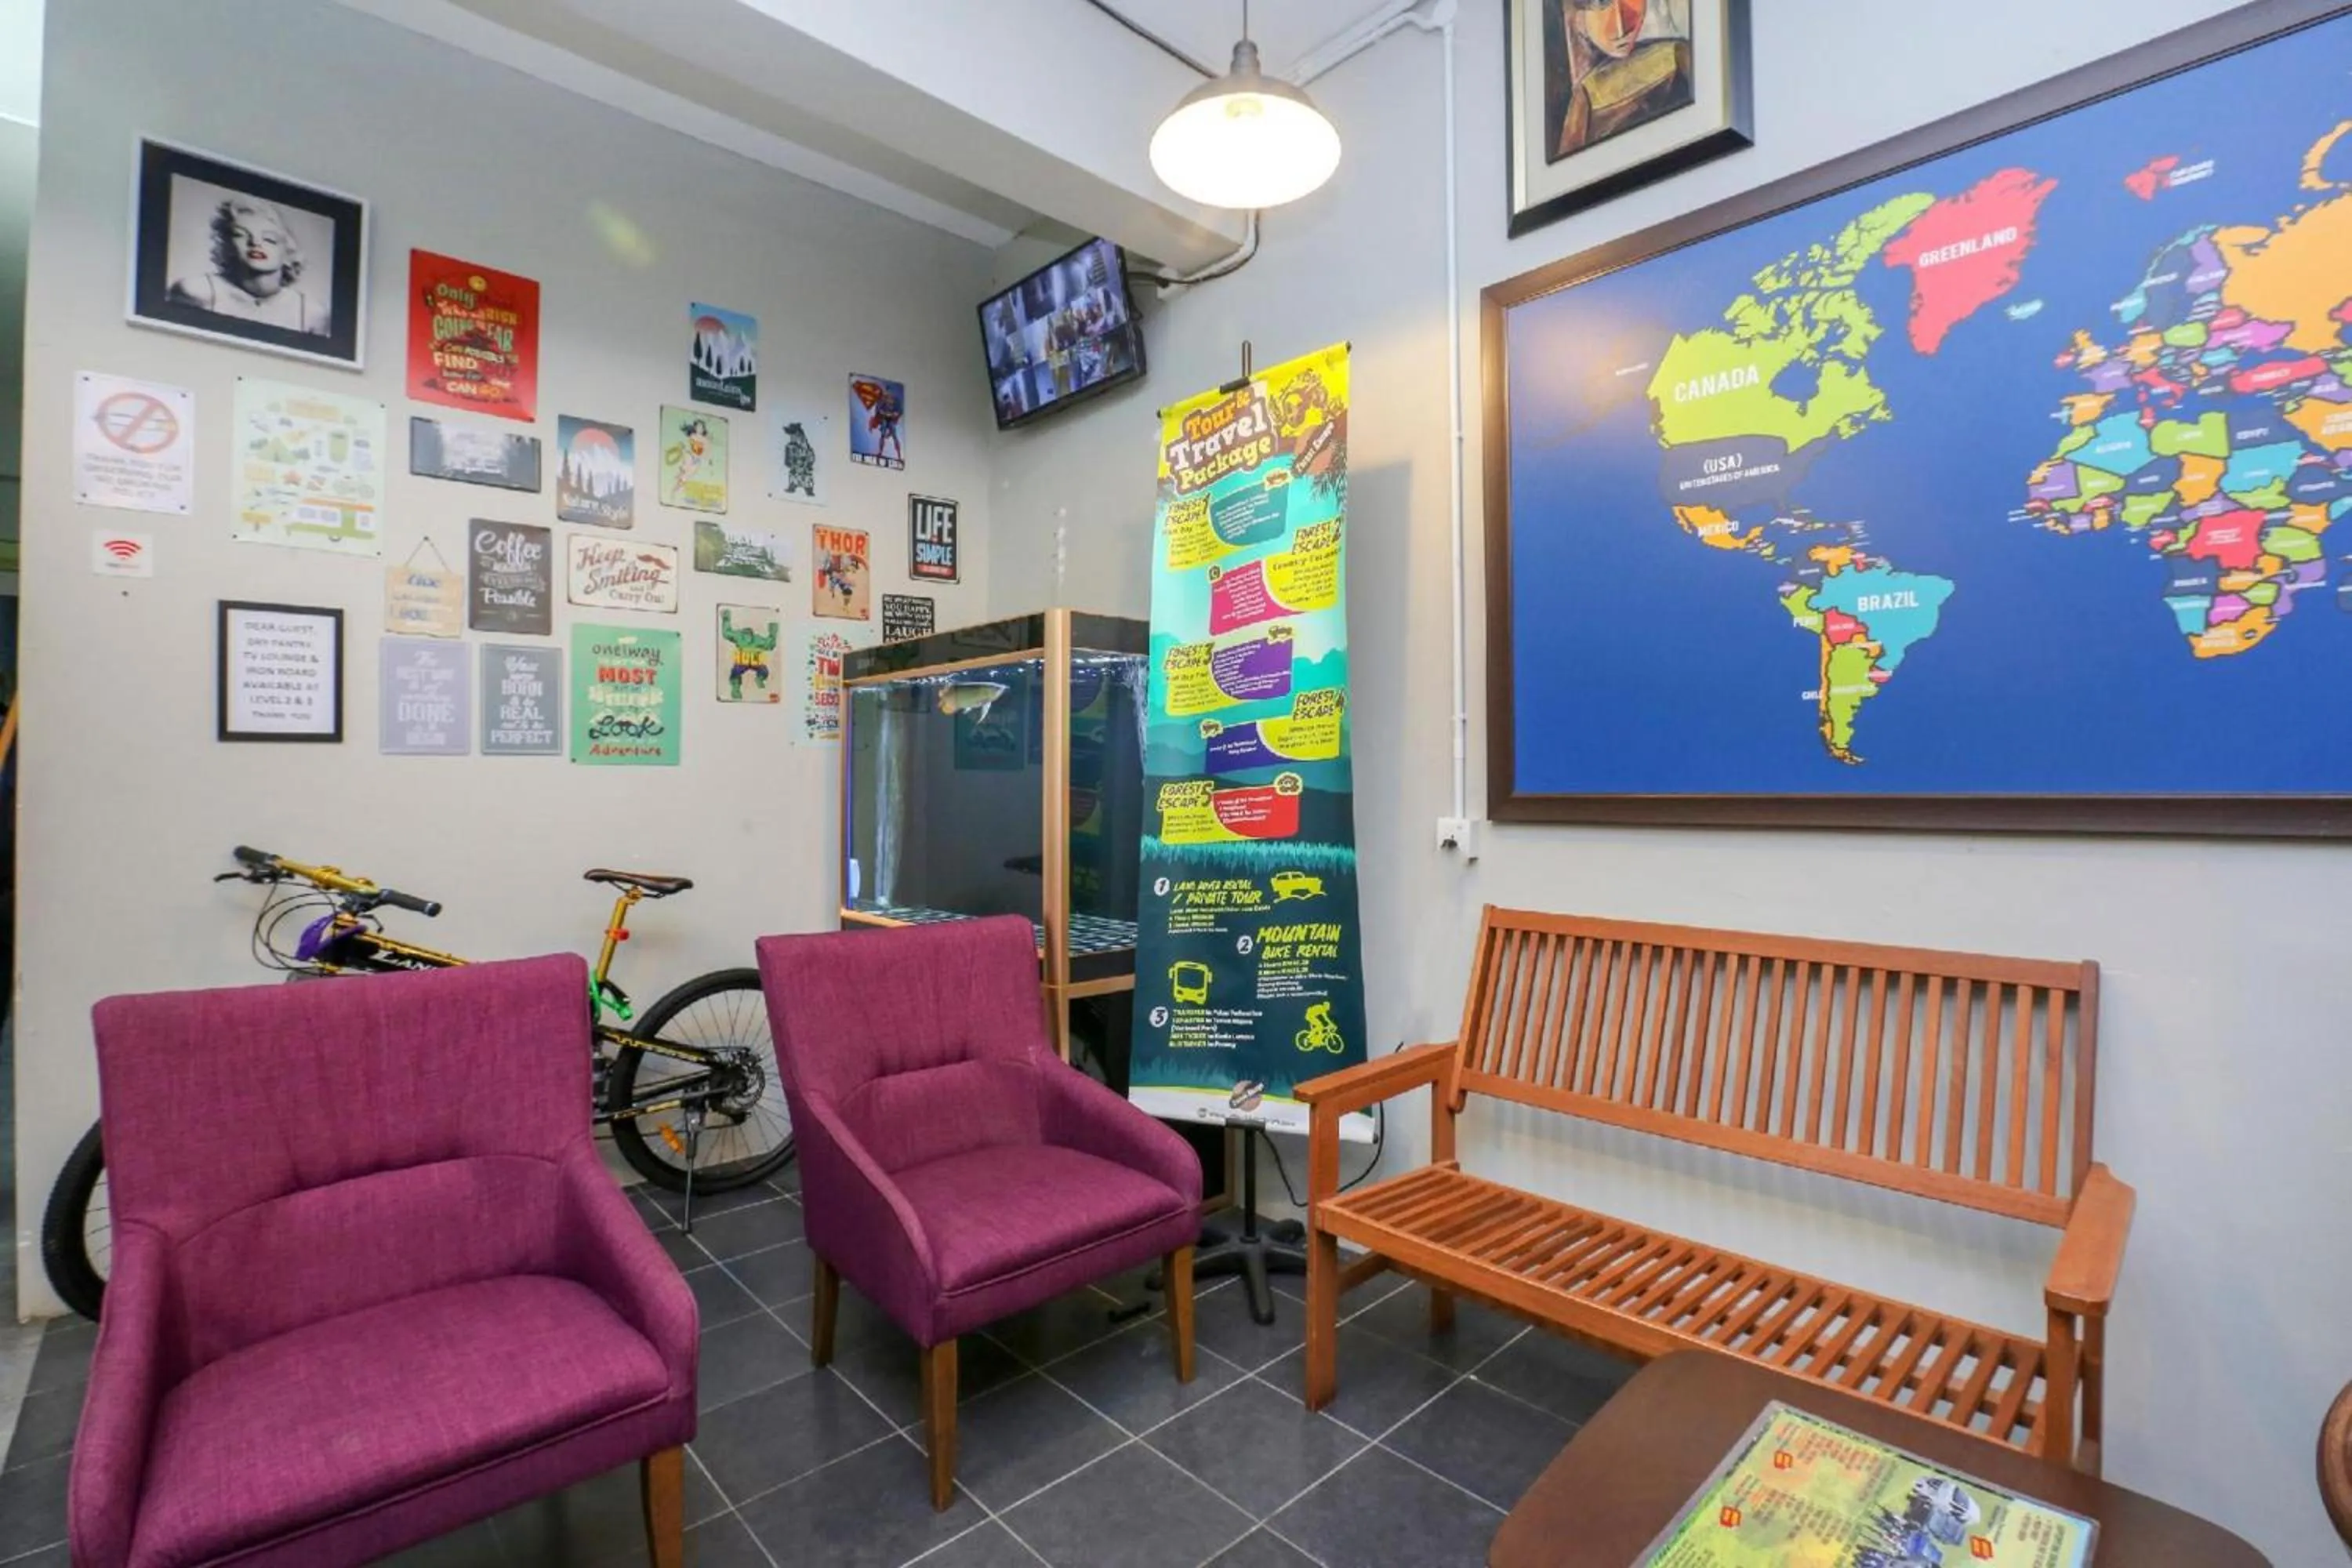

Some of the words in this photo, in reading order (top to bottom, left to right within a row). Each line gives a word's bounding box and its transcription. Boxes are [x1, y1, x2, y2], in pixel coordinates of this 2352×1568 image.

[1918, 226, 2018, 268] GREENLAND
[433, 351, 477, 368] FIND
[1673, 364, 1760, 403] CANADA
[1185, 401, 1238, 441] Tour
[1170, 402, 1269, 471] Travel
[1178, 435, 1272, 490] Package
[1703, 452, 1743, 474] (USA)
[915, 503, 954, 543] LIFE
[474, 530, 543, 565] Coffee
[816, 531, 867, 556] THOR
[915, 542, 953, 566] SIMPLE
[576, 542, 626, 572] Keep
[583, 561, 670, 595] Smiling
[608, 588, 642, 604] Carry
[1857, 590, 1919, 612] BRAZIL
[244, 621, 275, 631] DEAR
[243, 681, 303, 691] AVAILABLE
[598, 667, 657, 685] MOST
[500, 704, 546, 720] REAL
[491, 729, 554, 745] PERFECT
[589, 714, 665, 740] Look
[1231, 890, 1264, 904] TOUR
[1256, 924, 1341, 944] MOUNTAIN
